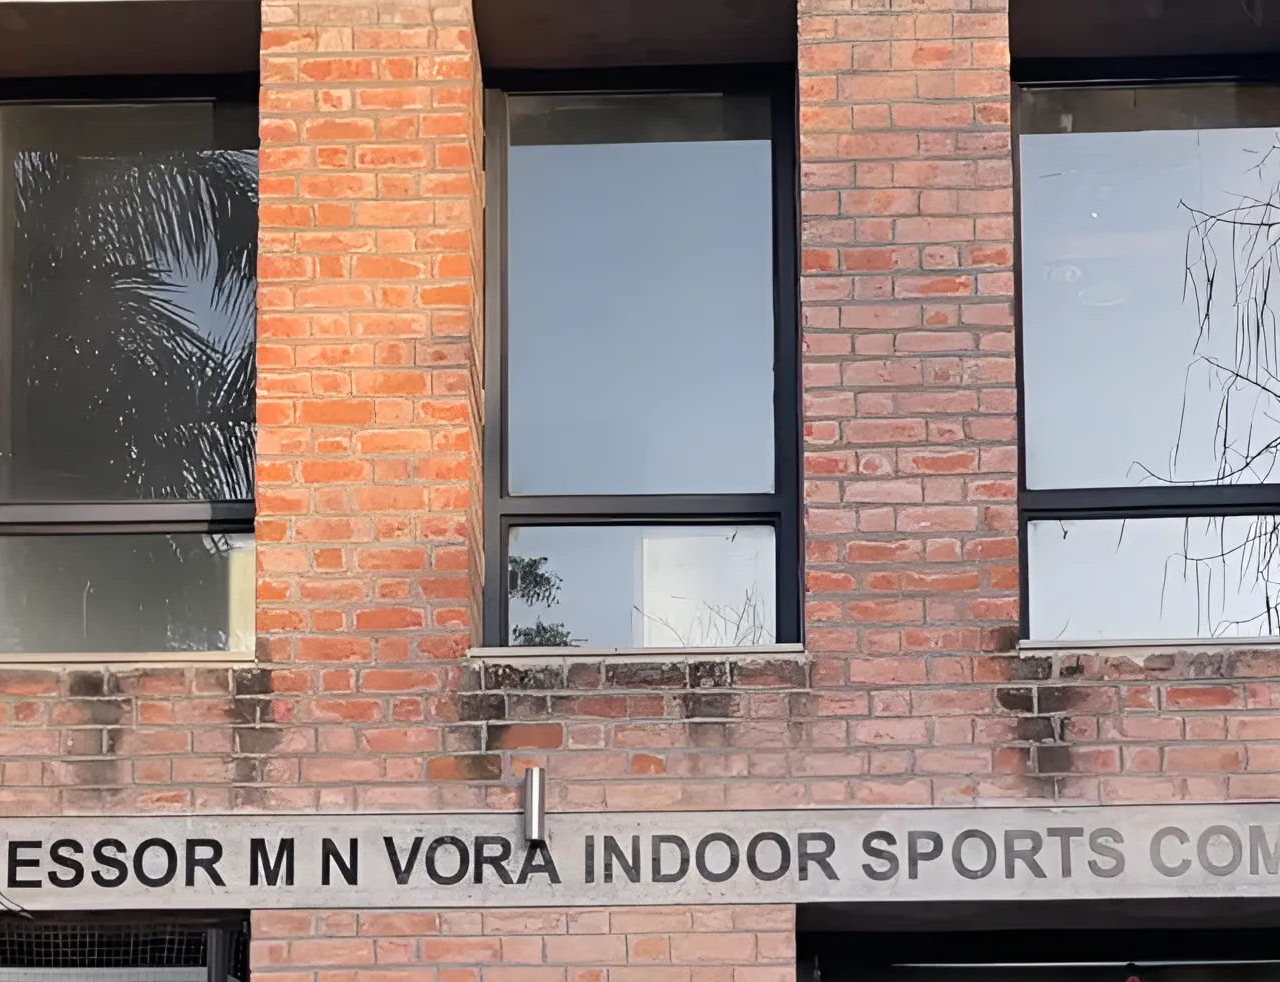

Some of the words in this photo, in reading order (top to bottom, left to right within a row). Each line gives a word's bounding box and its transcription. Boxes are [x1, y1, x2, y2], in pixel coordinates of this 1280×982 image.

[249, 835, 296, 887] M
[321, 837, 359, 887] N
[382, 834, 562, 887] VORA
[585, 829, 839, 884] INDOOR
[860, 827, 1125, 882] SPORTS
